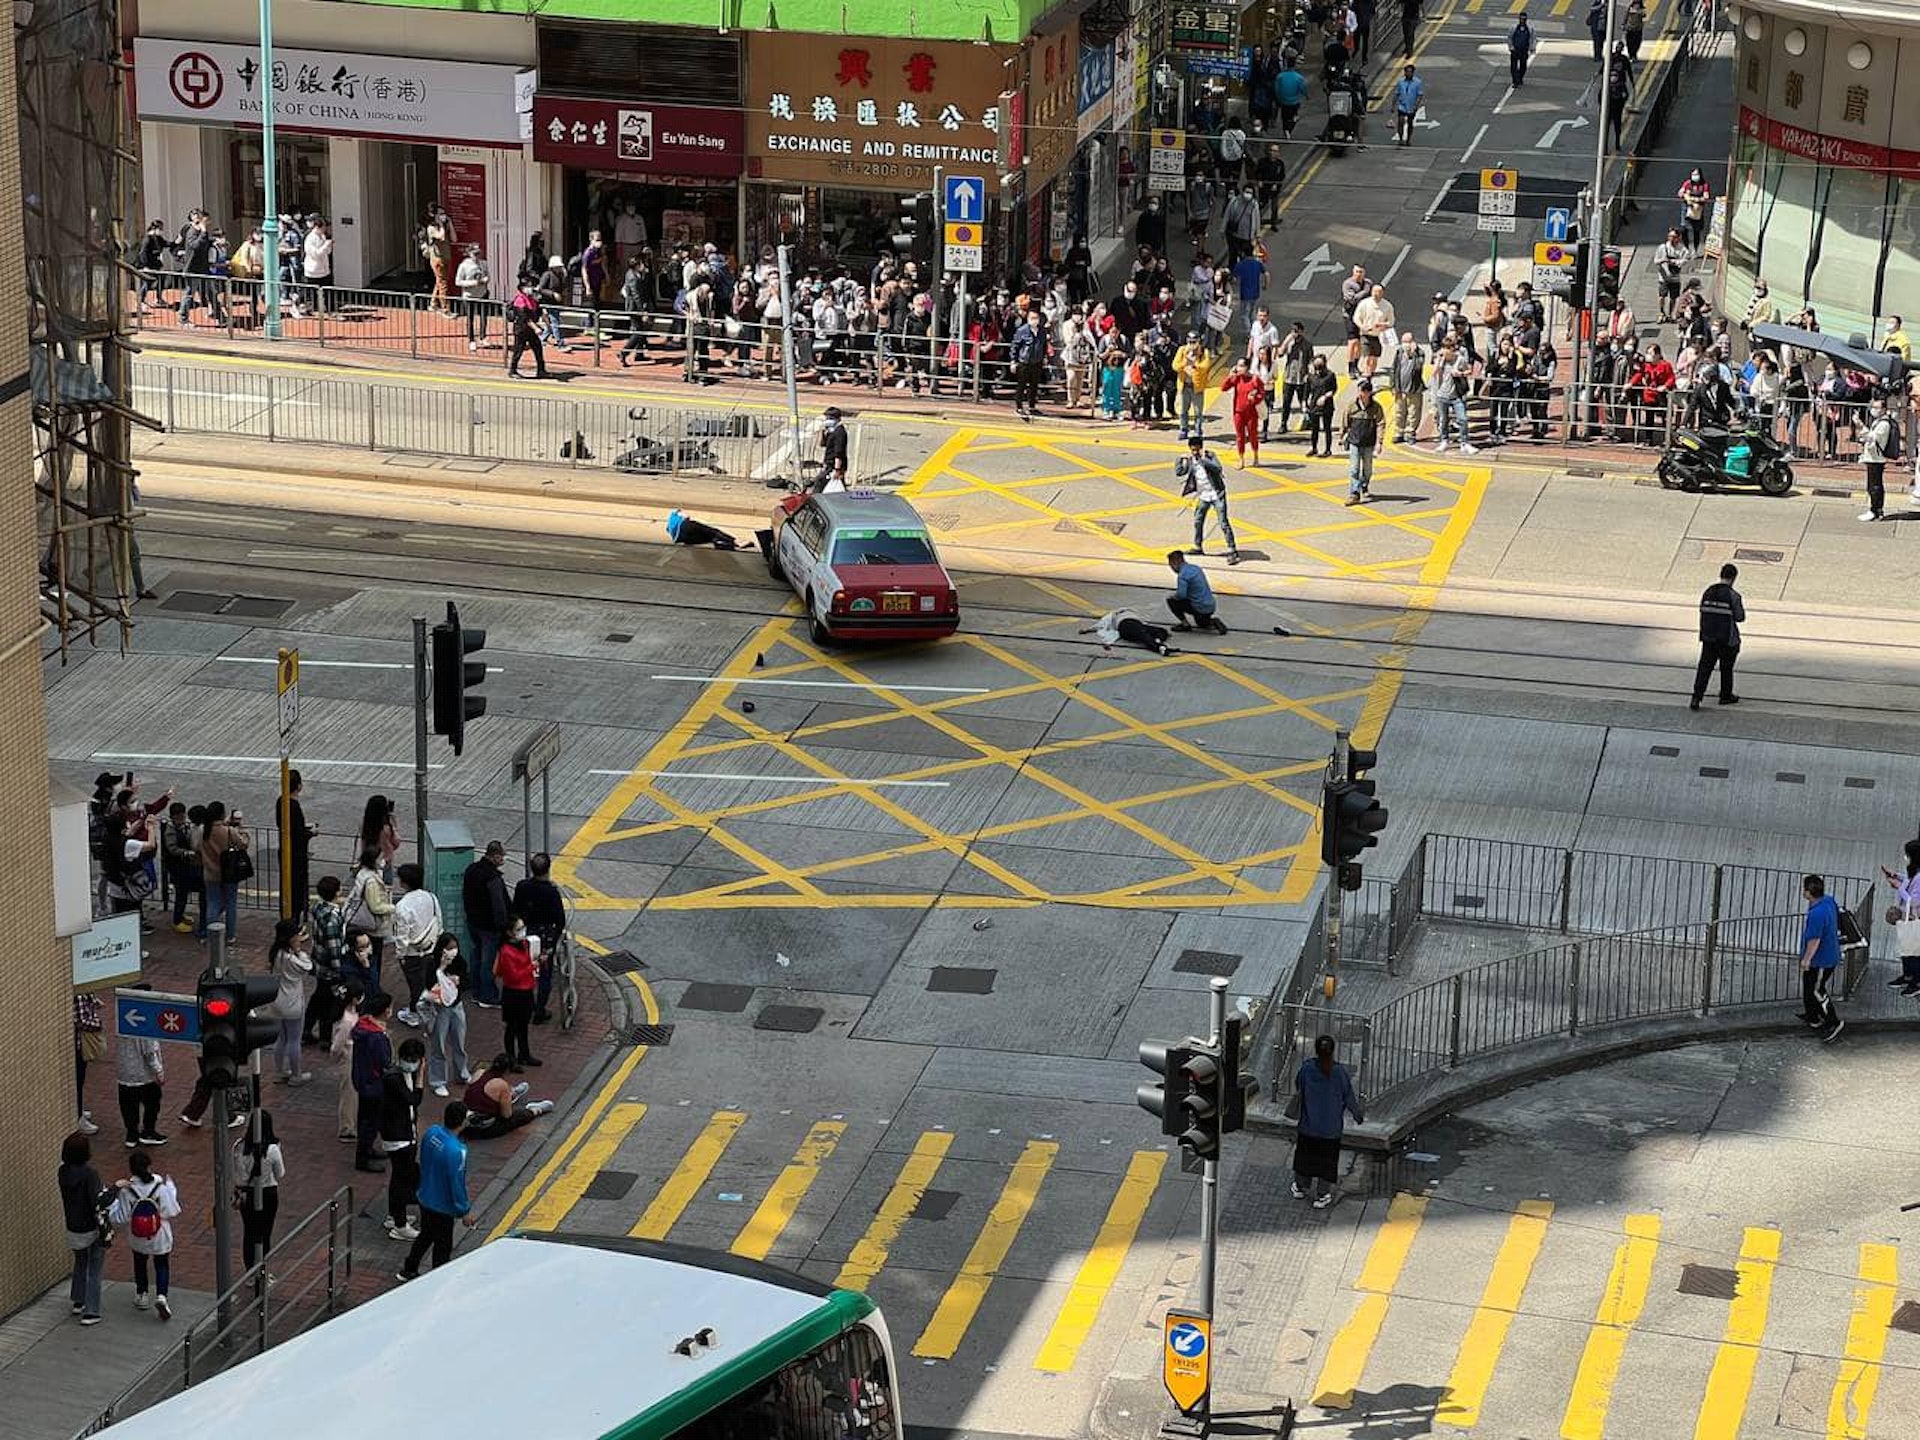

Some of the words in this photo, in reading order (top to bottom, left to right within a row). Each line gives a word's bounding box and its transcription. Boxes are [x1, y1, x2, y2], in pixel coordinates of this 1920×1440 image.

[834, 48, 937, 94] 興業
[239, 98, 280, 113] BAK
[285, 102, 305, 115] OF
[309, 105, 359, 120] CHINA
[548, 116, 608, 145] 余仁生
[662, 132, 677, 145] Eu
[677, 132, 697, 146] Yan
[697, 134, 726, 150] Sang
[768, 135, 852, 155] EXCHANGE
[863, 141, 895, 157] AND
[902, 143, 1000, 164] REMITTANCE
[1780, 126, 1842, 161] YAMAZAKI
[949, 247, 961, 255] 24
[1537, 267, 1550, 277] 24
